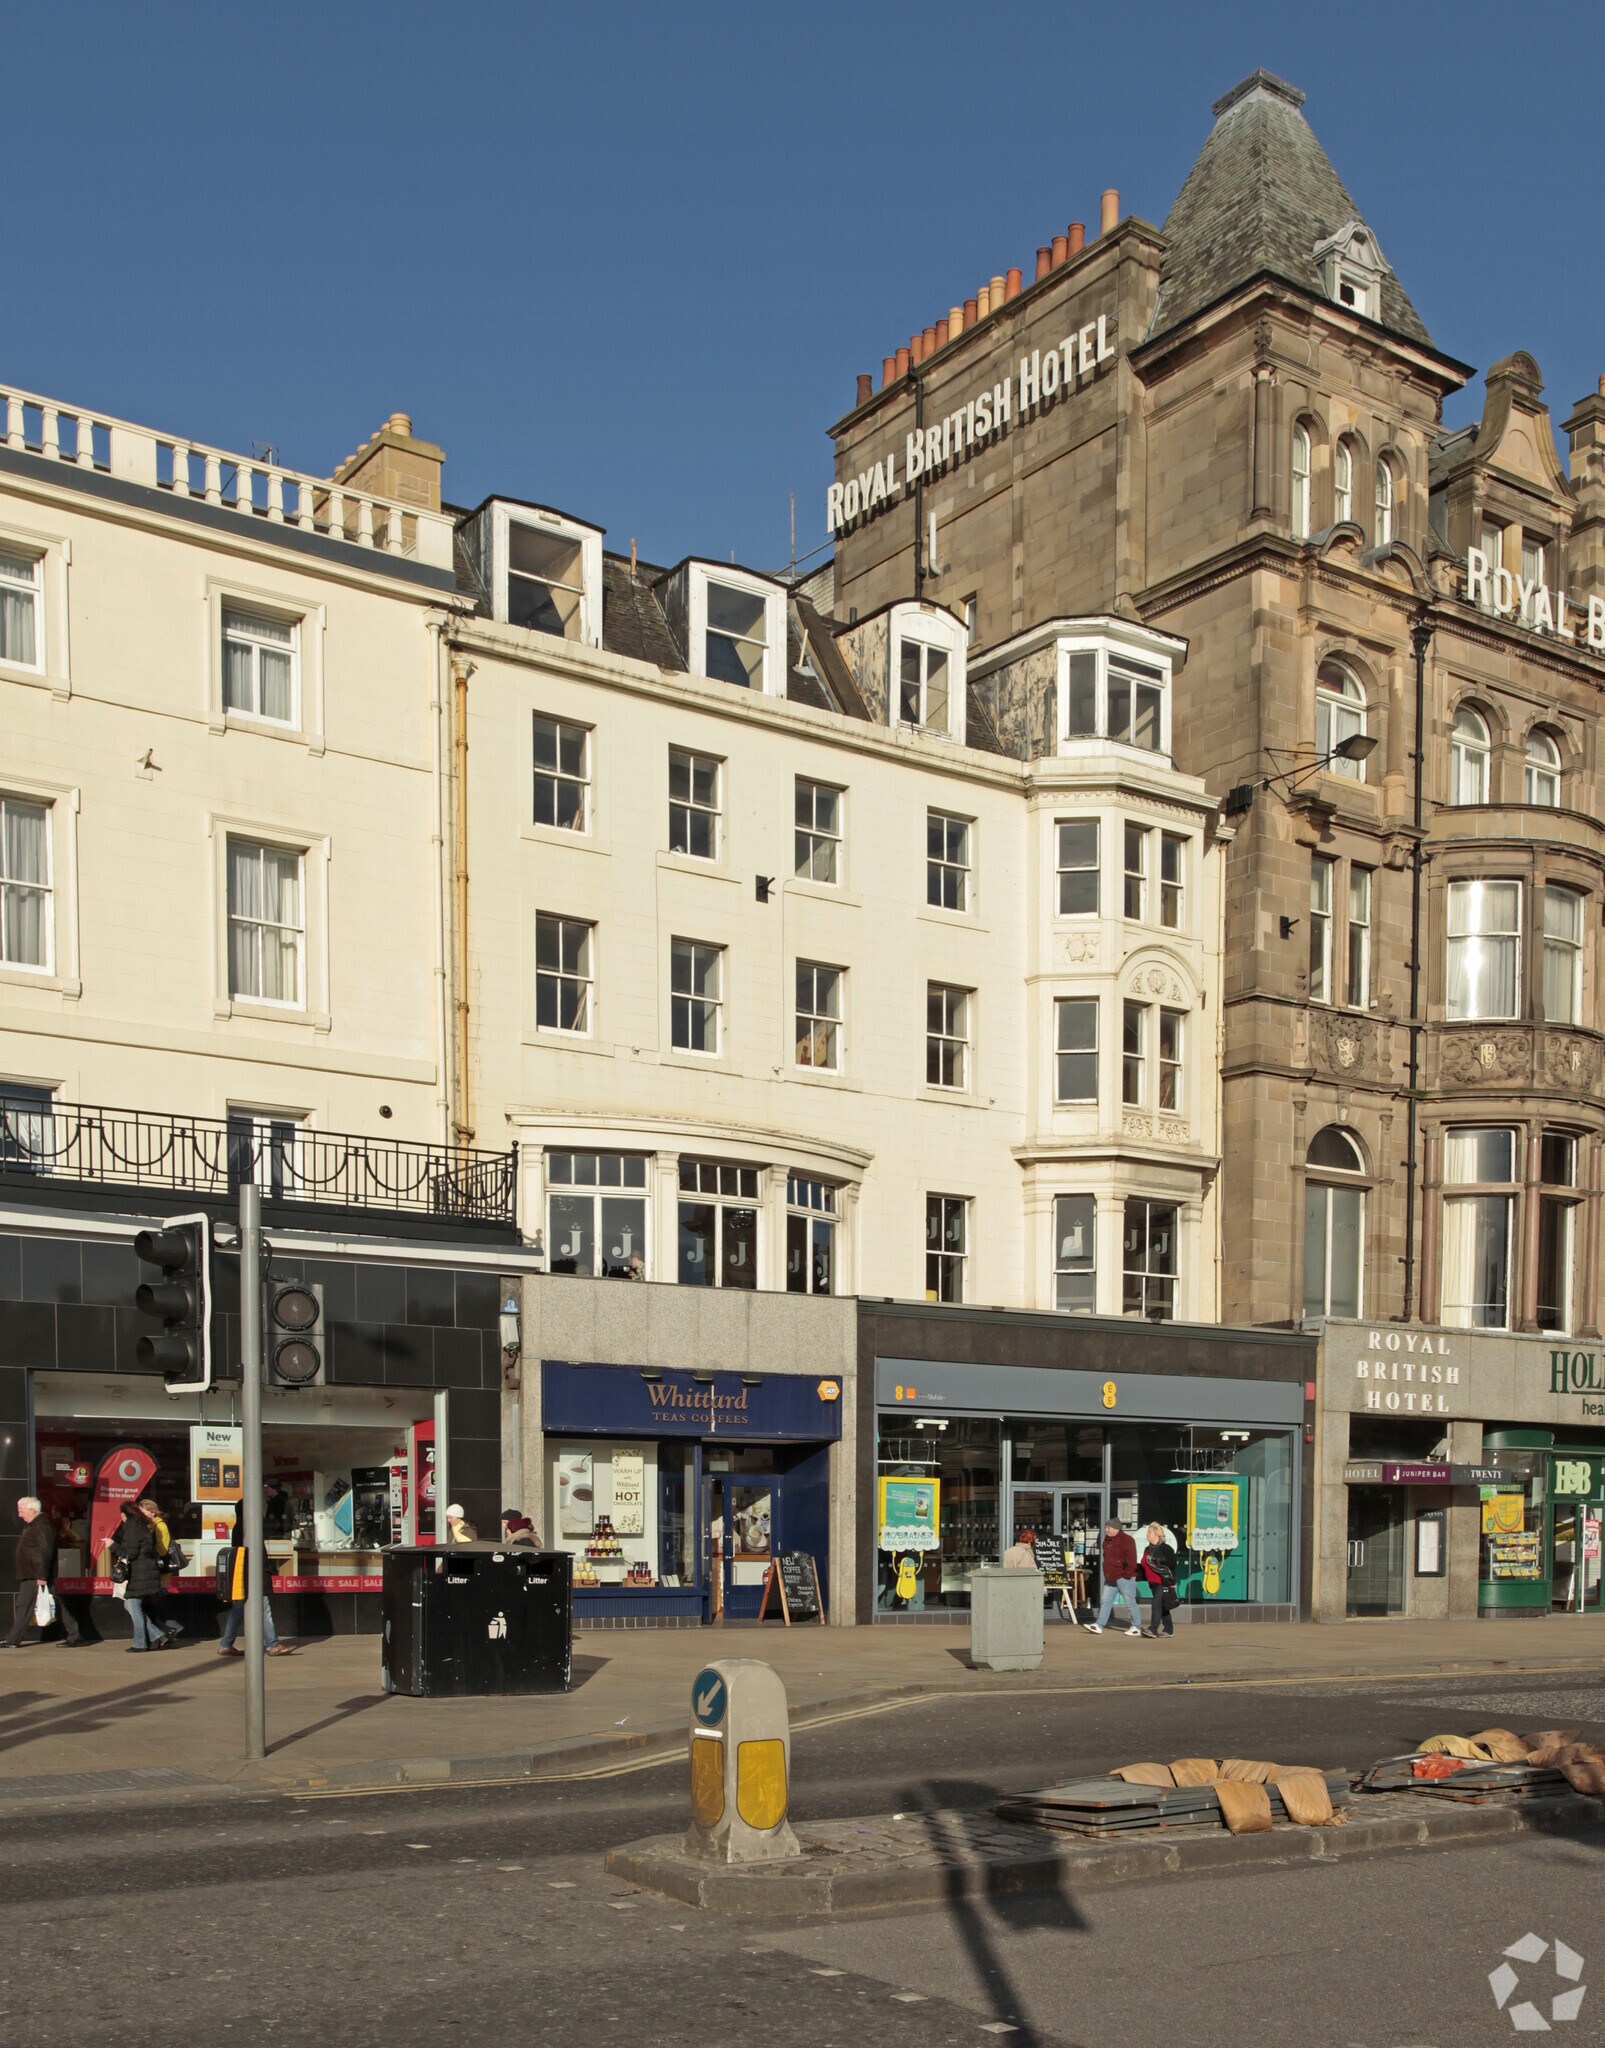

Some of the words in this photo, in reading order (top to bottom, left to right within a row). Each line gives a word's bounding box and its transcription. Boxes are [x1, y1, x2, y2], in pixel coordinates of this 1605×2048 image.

[827, 453, 901, 534] ROYAL
[906, 377, 1011, 482] BRITISH
[1019, 314, 1115, 412] HOTEL
[1467, 546, 1574, 639] ROYAL
[1368, 1331, 1450, 1355] ROYAL
[1356, 1360, 1459, 1385] BRITISH
[646, 1384, 748, 1410] Whittard
[1367, 1390, 1449, 1413] HOTEL
[652, 1412, 686, 1422] TEAS
[691, 1413, 748, 1424] COFFEES
[206, 1431, 232, 1442] New
[1345, 1469, 1380, 1479] HOTEL
[1470, 1469, 1503, 1479] TWENTY
[1554, 1460, 1592, 1495] H&B
[615, 1491, 640, 1501] HOT
[63, 1581, 87, 1590] SALE
[178, 1580, 200, 1589] SALE
[286, 1580, 308, 1588] SALE
[312, 1580, 334, 1588] SALE
[338, 1580, 360, 1588] SALE
[447, 1577, 468, 1585] Litter
[528, 1577, 548, 1585] Litter
